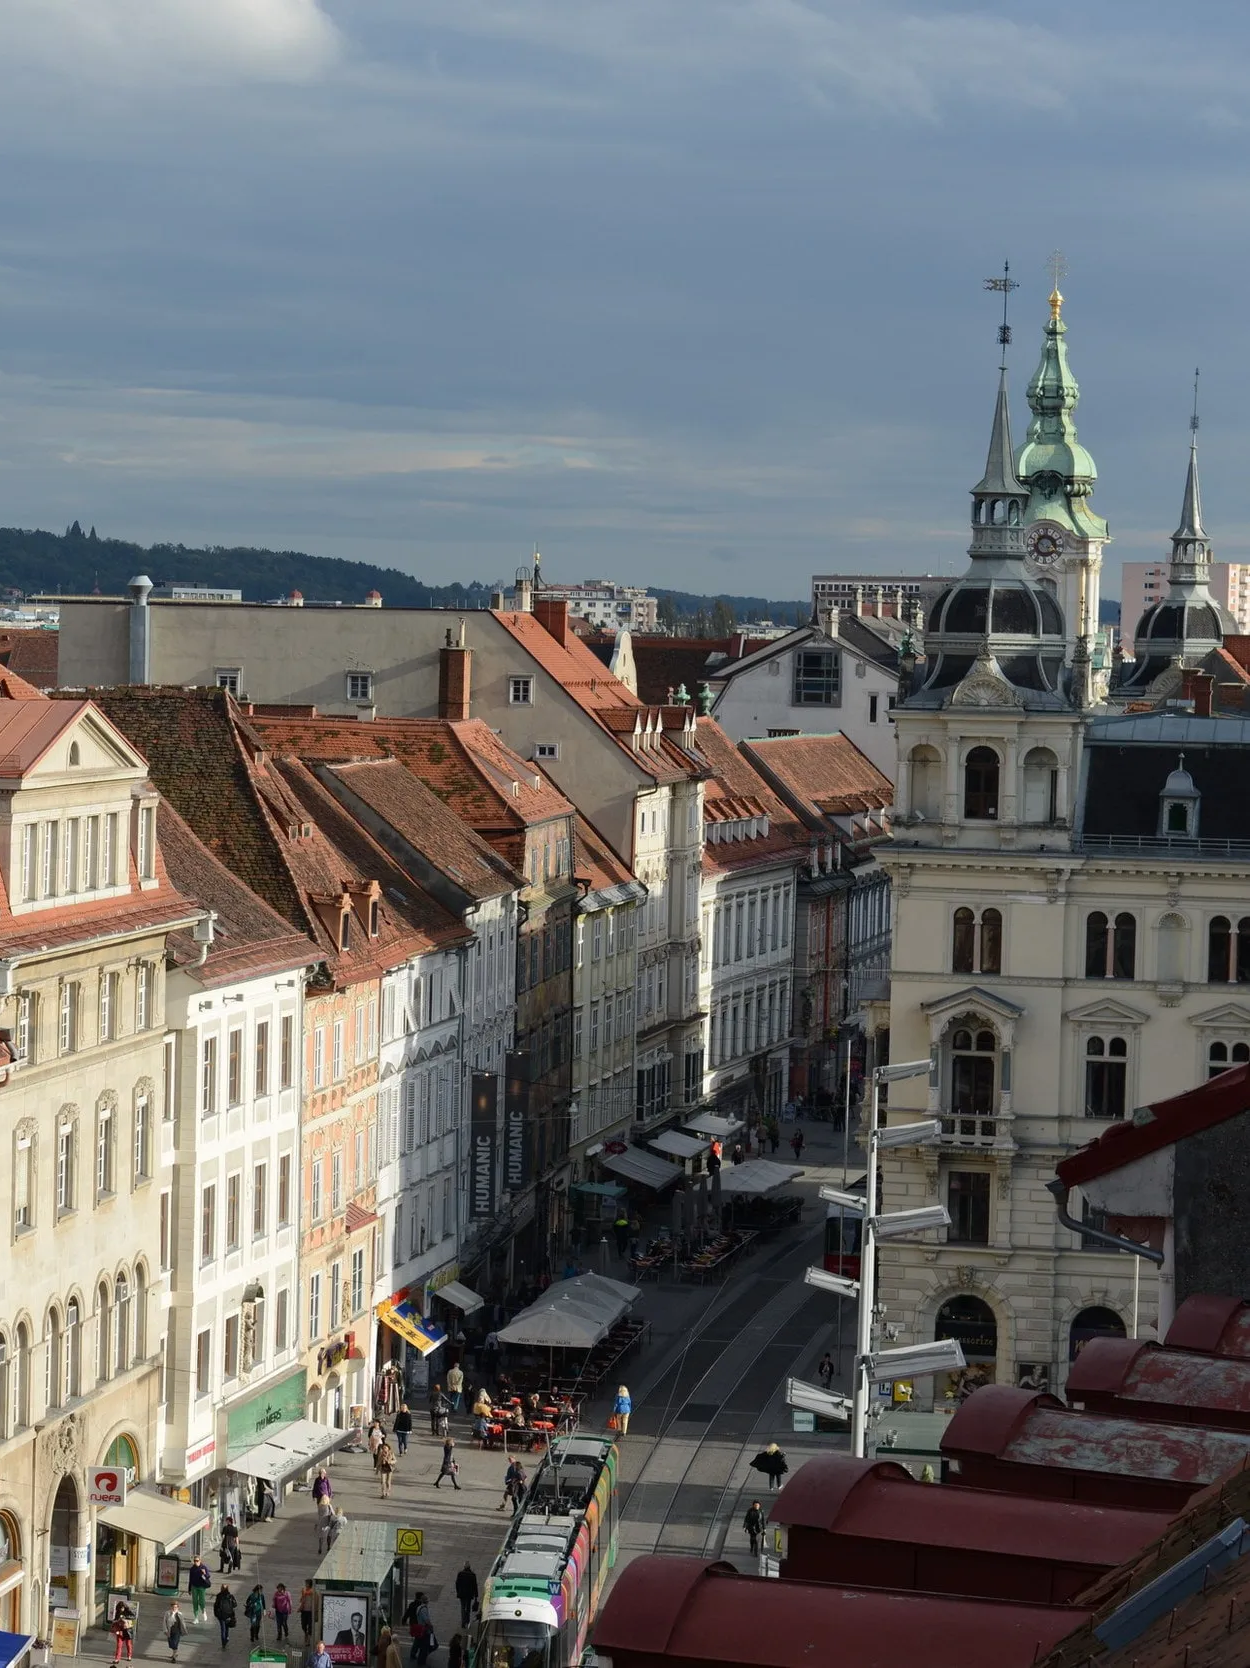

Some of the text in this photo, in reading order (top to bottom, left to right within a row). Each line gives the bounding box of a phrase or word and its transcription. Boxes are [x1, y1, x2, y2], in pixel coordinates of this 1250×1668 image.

[508, 1111, 523, 1184] HUMANIC
[475, 1135, 491, 1212] HUMANIC
[941, 1332, 994, 1346] Aessorize
[90, 1493, 122, 1503] ruefa
[549, 1583, 560, 1595] W
